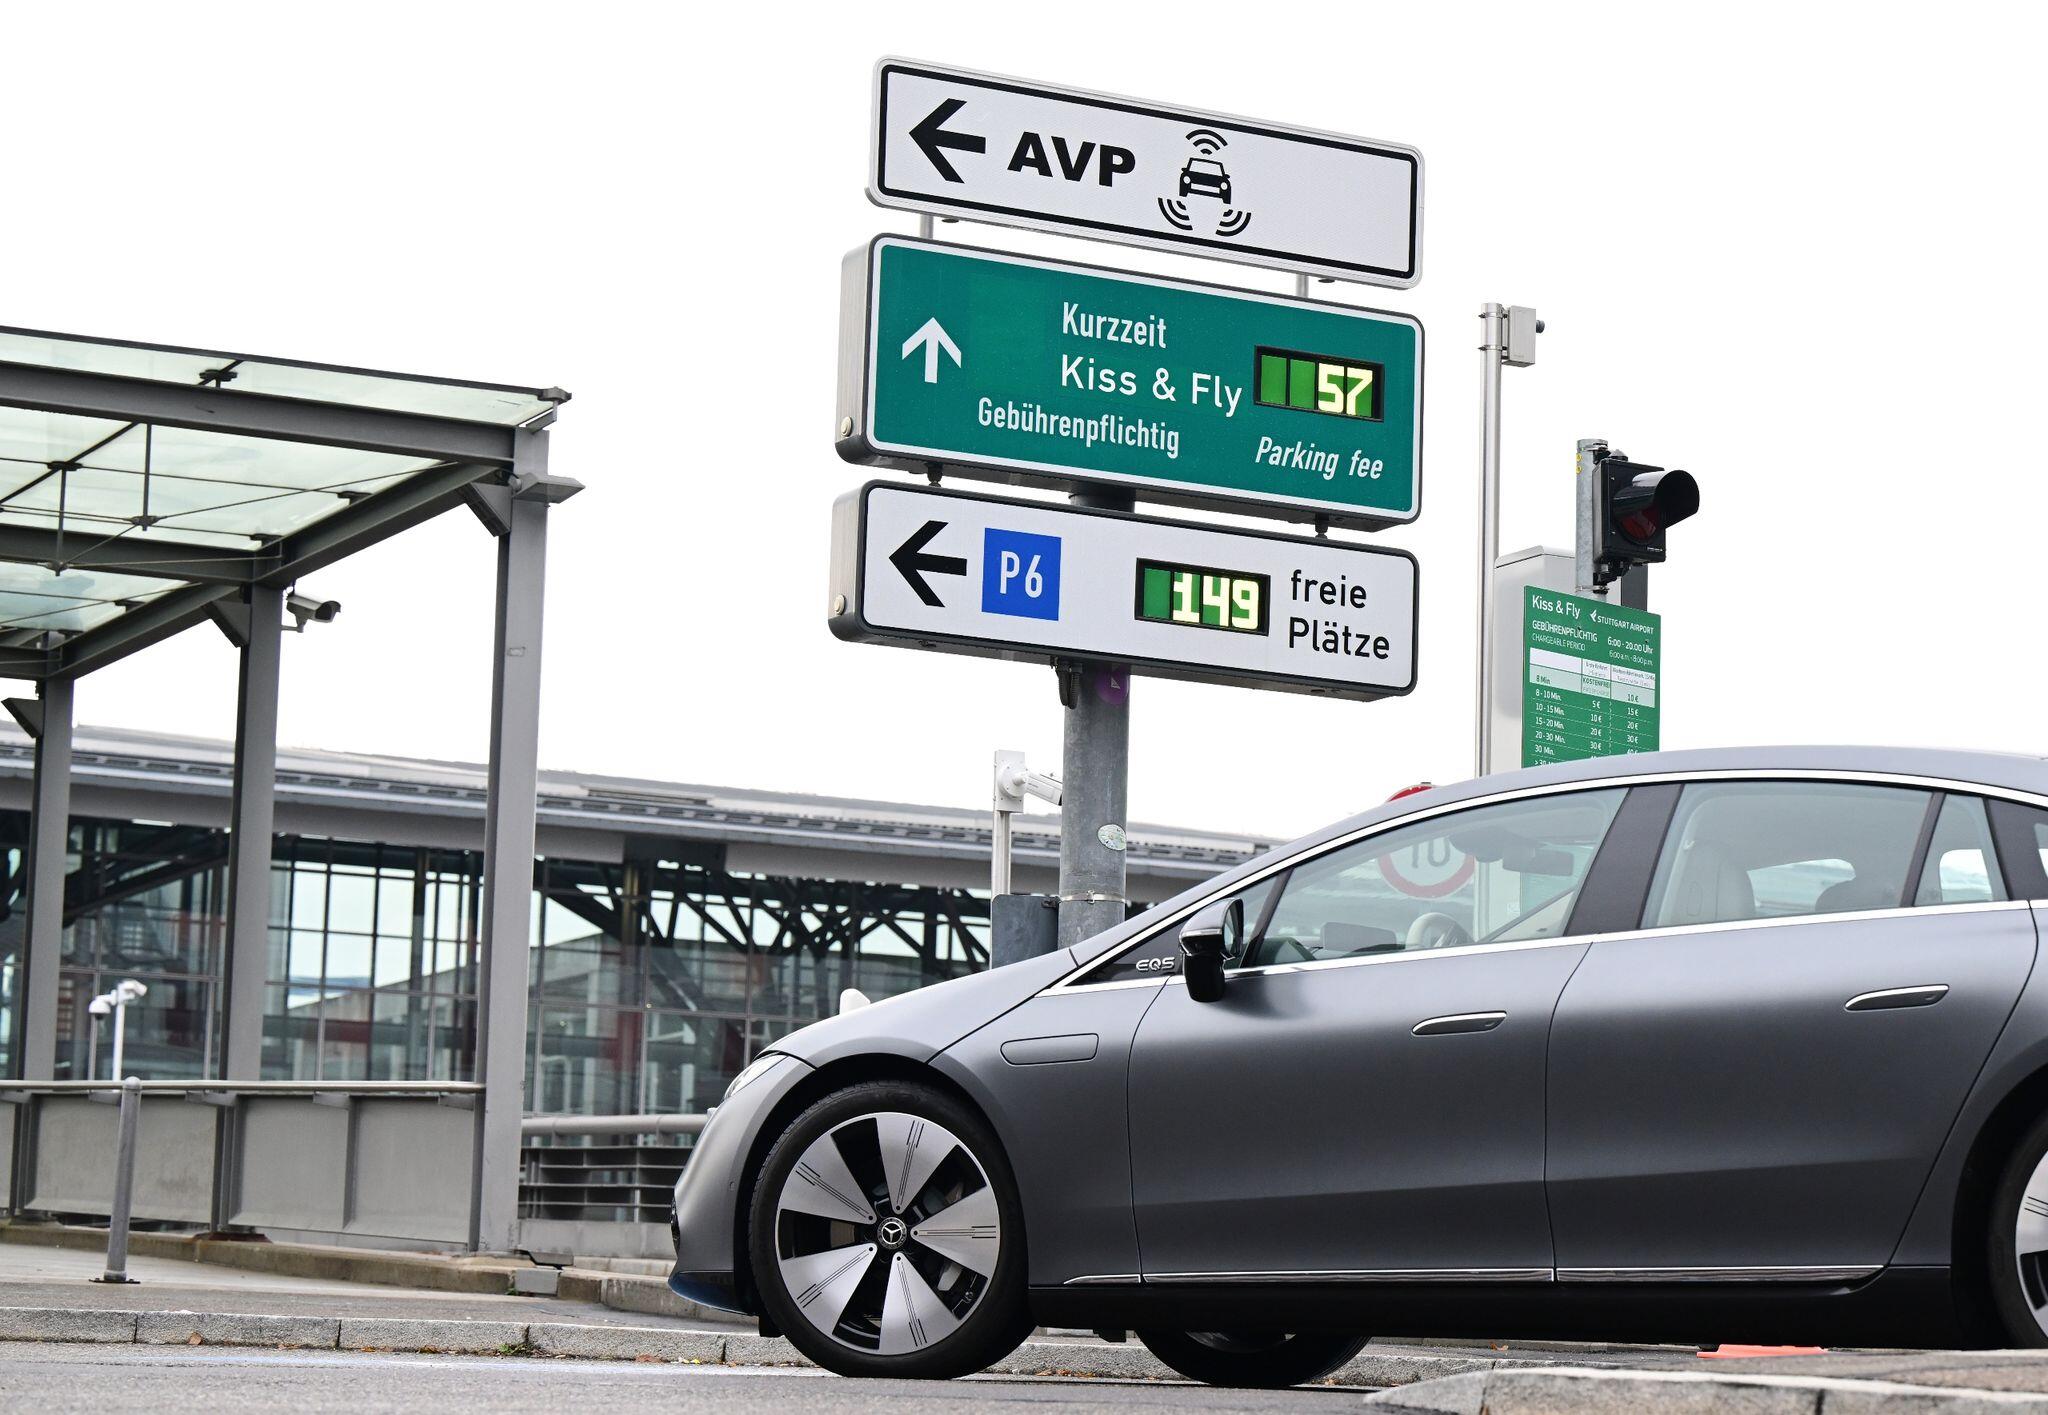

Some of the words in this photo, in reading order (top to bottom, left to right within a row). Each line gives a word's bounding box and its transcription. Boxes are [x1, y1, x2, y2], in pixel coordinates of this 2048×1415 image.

[1007, 131, 1136, 187] AVP
[1062, 301, 1167, 349] Kurzzeit
[1061, 354, 1137, 396] Kiss
[1152, 367, 1177, 402] &
[1192, 372, 1243, 418] Fly
[1317, 362, 1373, 416] 57
[978, 397, 1180, 459] Gebührenpflichtig
[1255, 436, 1340, 481] Parking
[1348, 450, 1384, 480] fee
[1000, 550, 1043, 598] P6
[1290, 569, 1367, 609] freie
[1172, 571, 1260, 630] 149
[1532, 595, 1553, 612] Kiss
[1555, 600, 1564, 615] &
[1566, 602, 1581, 620] Fly
[1289, 616, 1390, 660] Plätze
[1597, 615, 1630, 630] STUTTGART
[1629, 622, 1654, 635] AIRPORT
[1535, 688, 1540, 697] 8
[1535, 702, 1543, 711] 10
[1535, 716, 1543, 725] 15
[1535, 730, 1543, 739] 20
[1535, 744, 1543, 753] 30
[1411, 836, 1452, 869] 10
[1135, 956, 1175, 972] EQS
